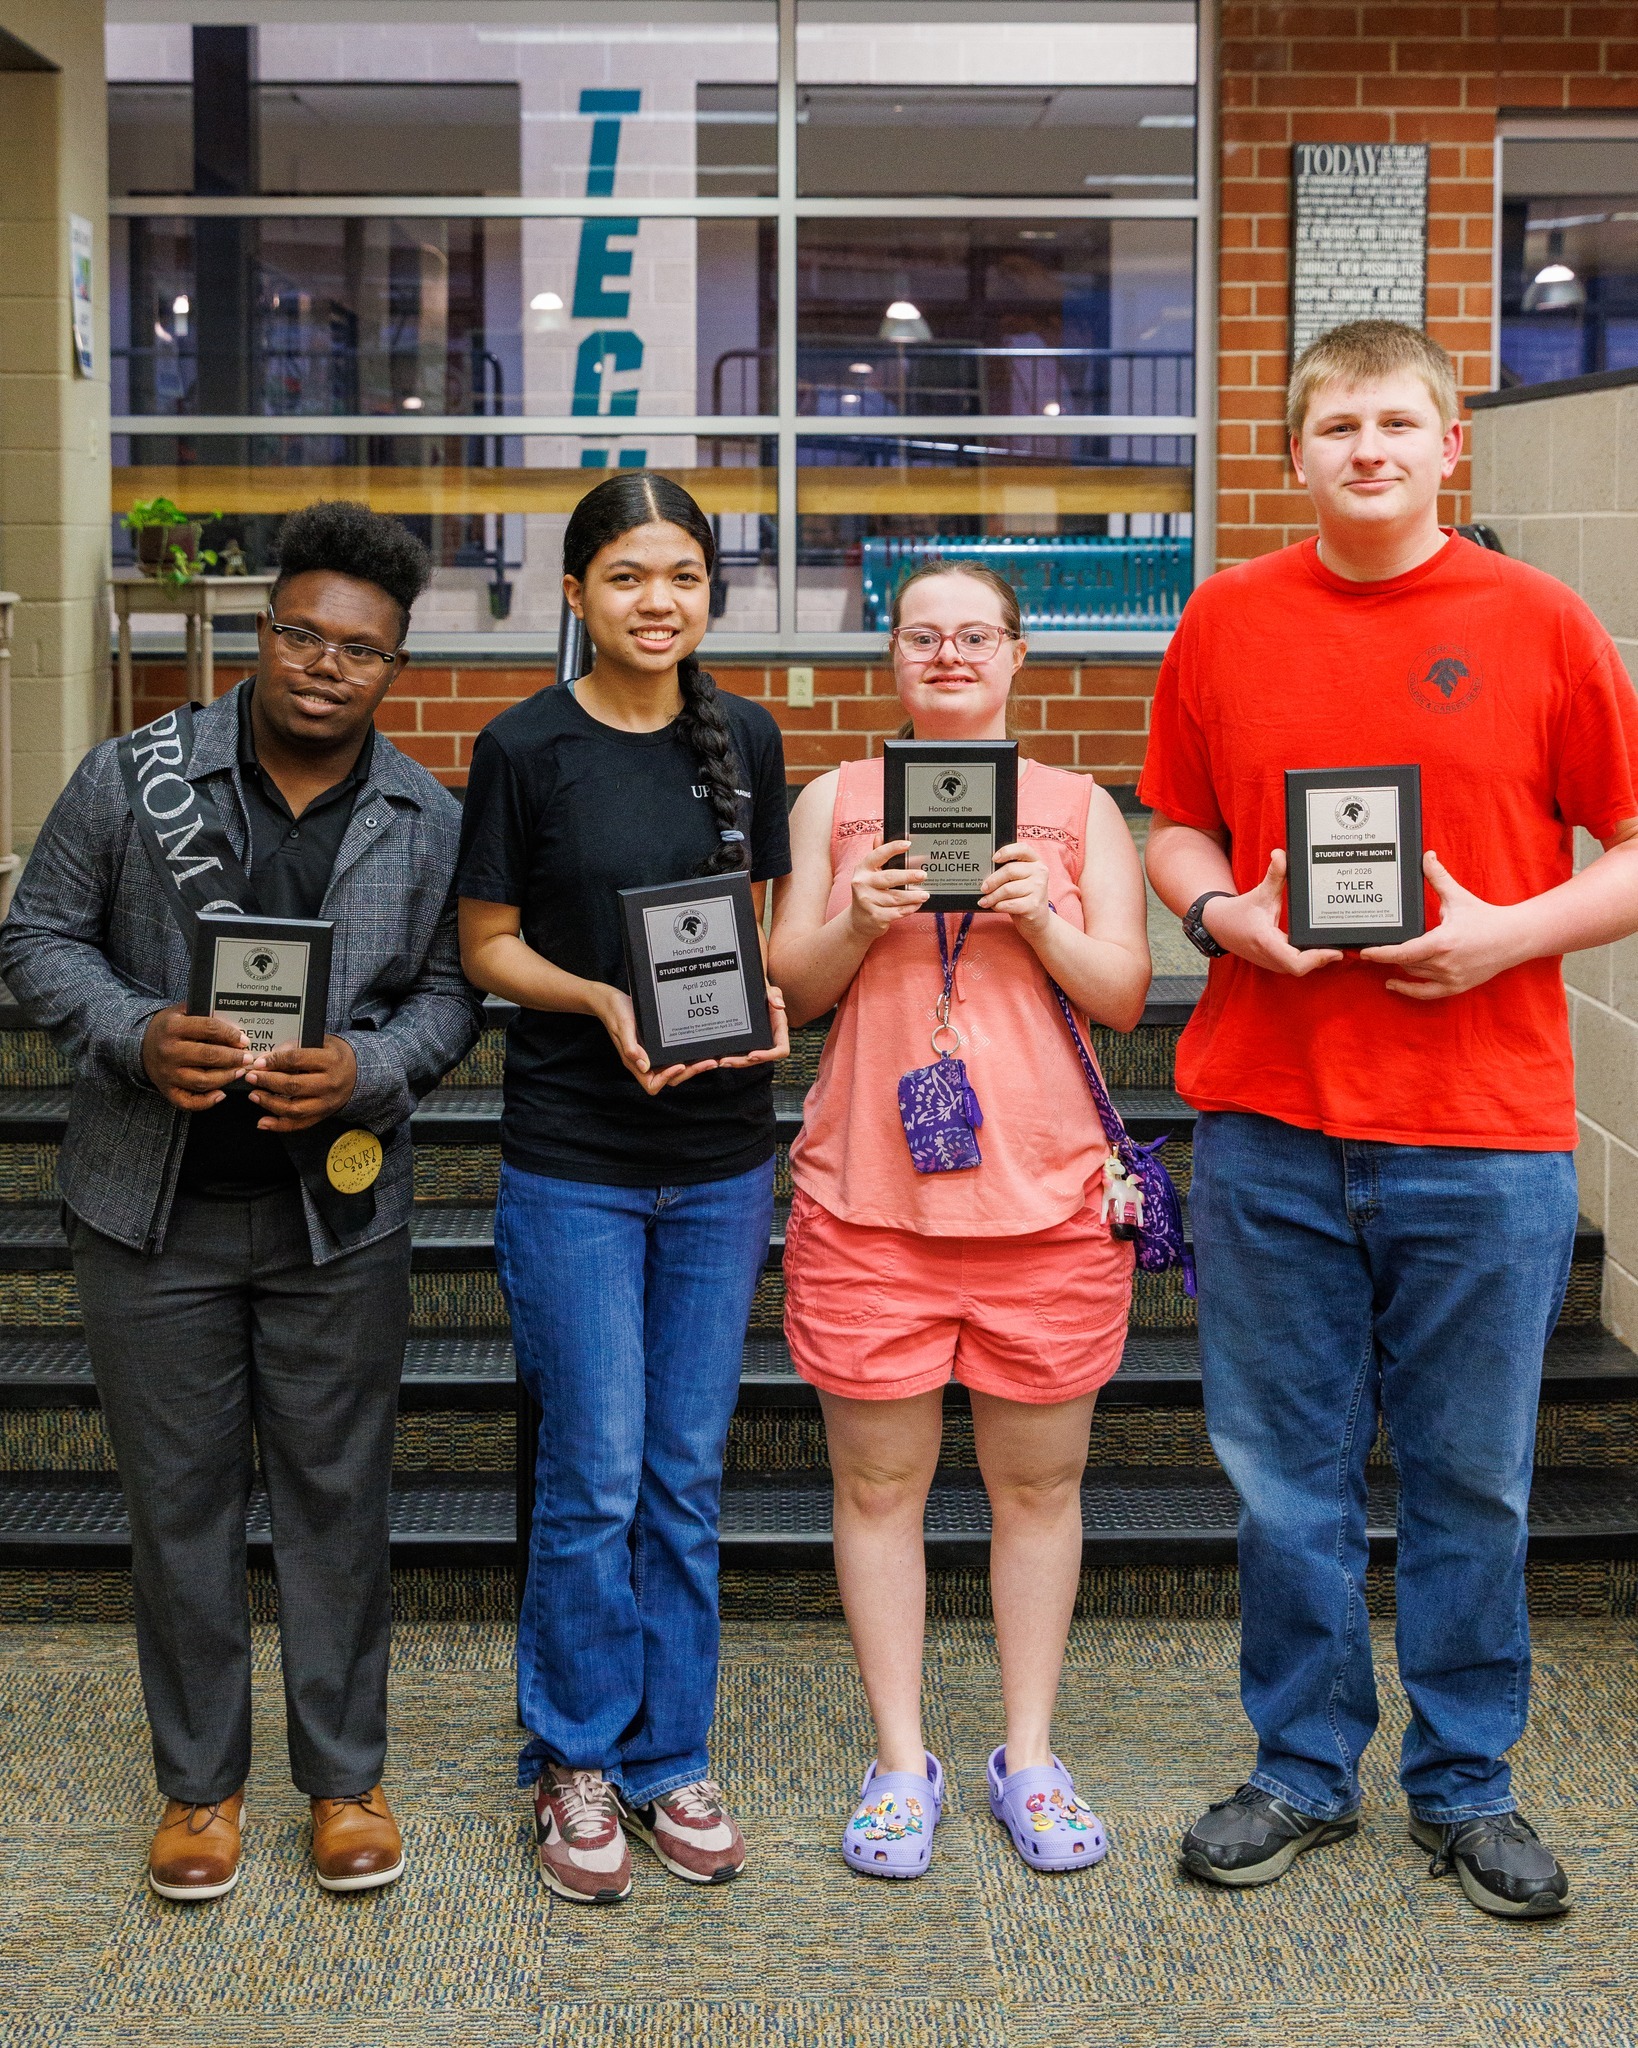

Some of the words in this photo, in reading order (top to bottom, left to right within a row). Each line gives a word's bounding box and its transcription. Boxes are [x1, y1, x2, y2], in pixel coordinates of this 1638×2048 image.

[1297, 144, 1381, 176] TODAY
[1037, 560, 1114, 588] Tech
[132, 710, 223, 890] PROM
[931, 851, 970, 859] MAEVE
[921, 863, 979, 872] GOLICHER
[1336, 881, 1373, 890] TYLER
[1328, 894, 1383, 904] DOWLING
[672, 947, 704, 956] Honoring
[659, 966, 688, 975] STUDENT
[712, 959, 735, 967] MONTH
[237, 983, 269, 991] Honoring
[682, 983, 698, 991] April
[700, 979, 717, 988] 2026
[689, 993, 713, 1004] LILY
[688, 1005, 719, 1018] DOSS
[333, 1145, 376, 1172] COURT
[351, 1158, 376, 1172] 2026
